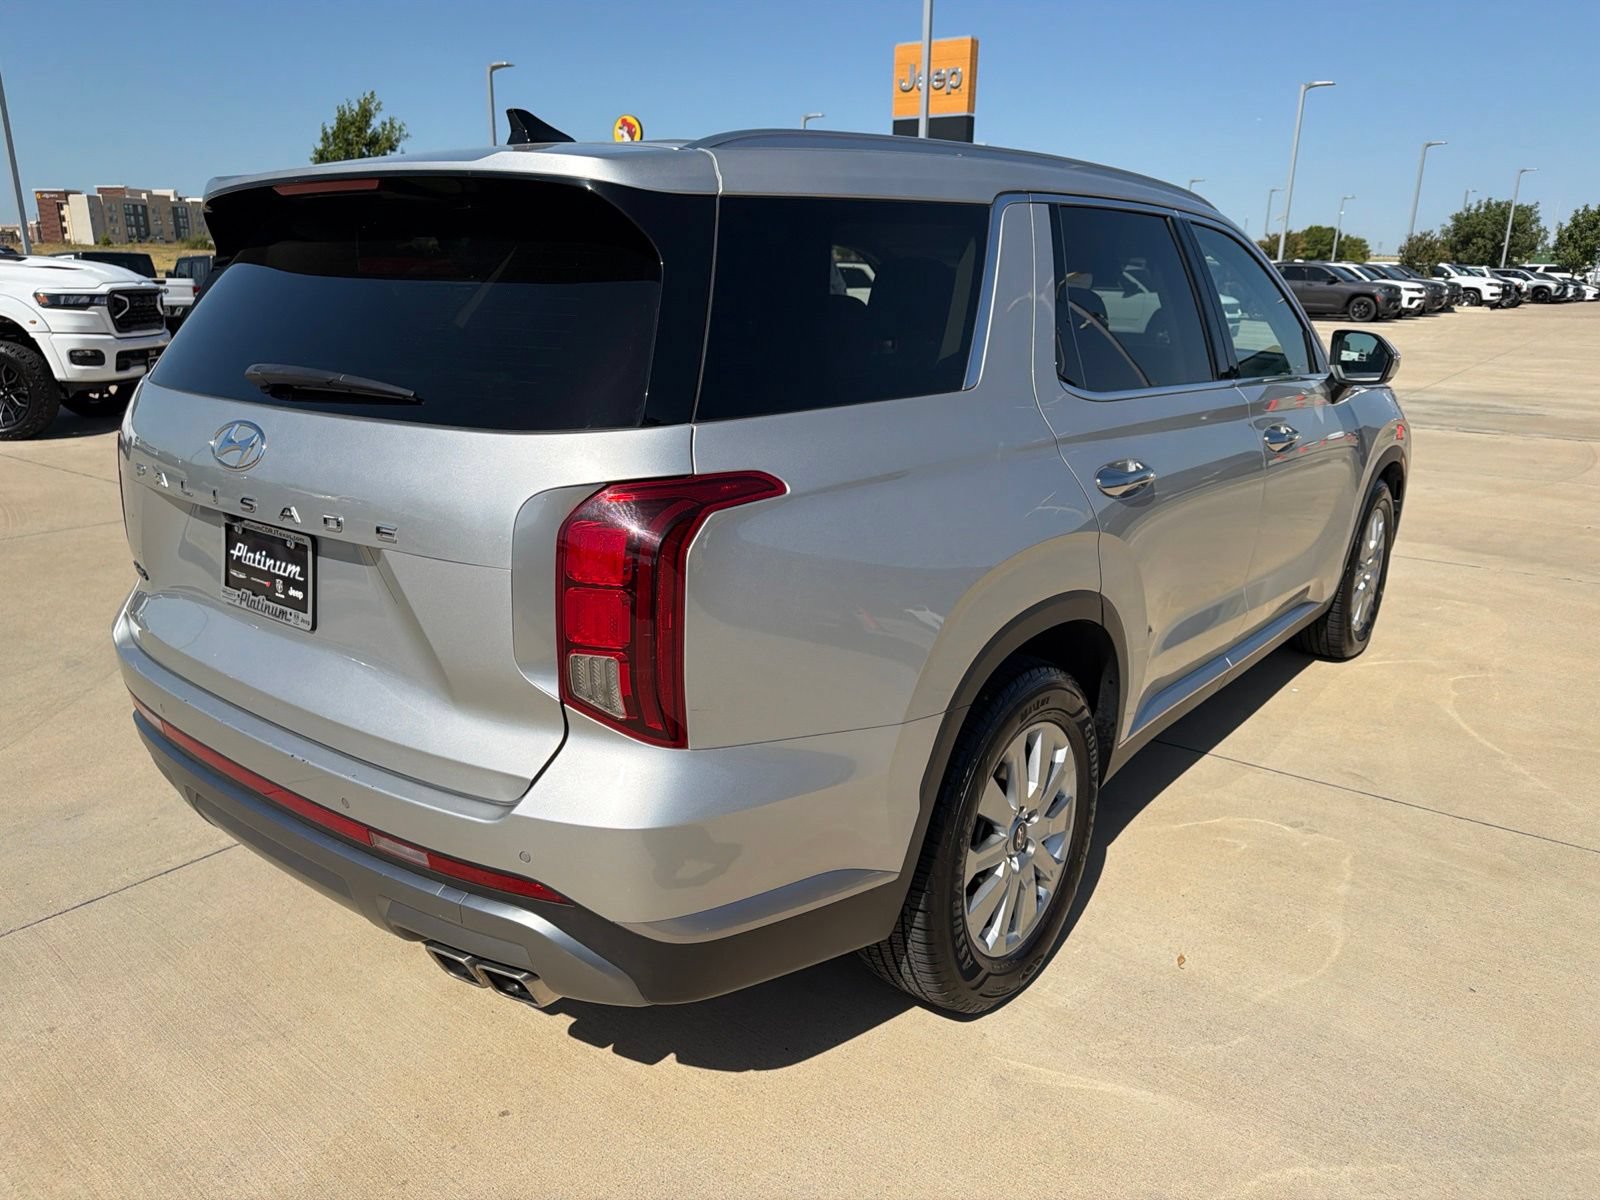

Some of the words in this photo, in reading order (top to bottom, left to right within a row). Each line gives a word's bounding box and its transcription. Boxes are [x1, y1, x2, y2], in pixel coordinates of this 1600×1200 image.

[135, 462, 399, 545] PALISADE
[230, 542, 304, 581] Platinum
[239, 591, 291, 623] Platinum
[288, 586, 304, 600] Jeep
